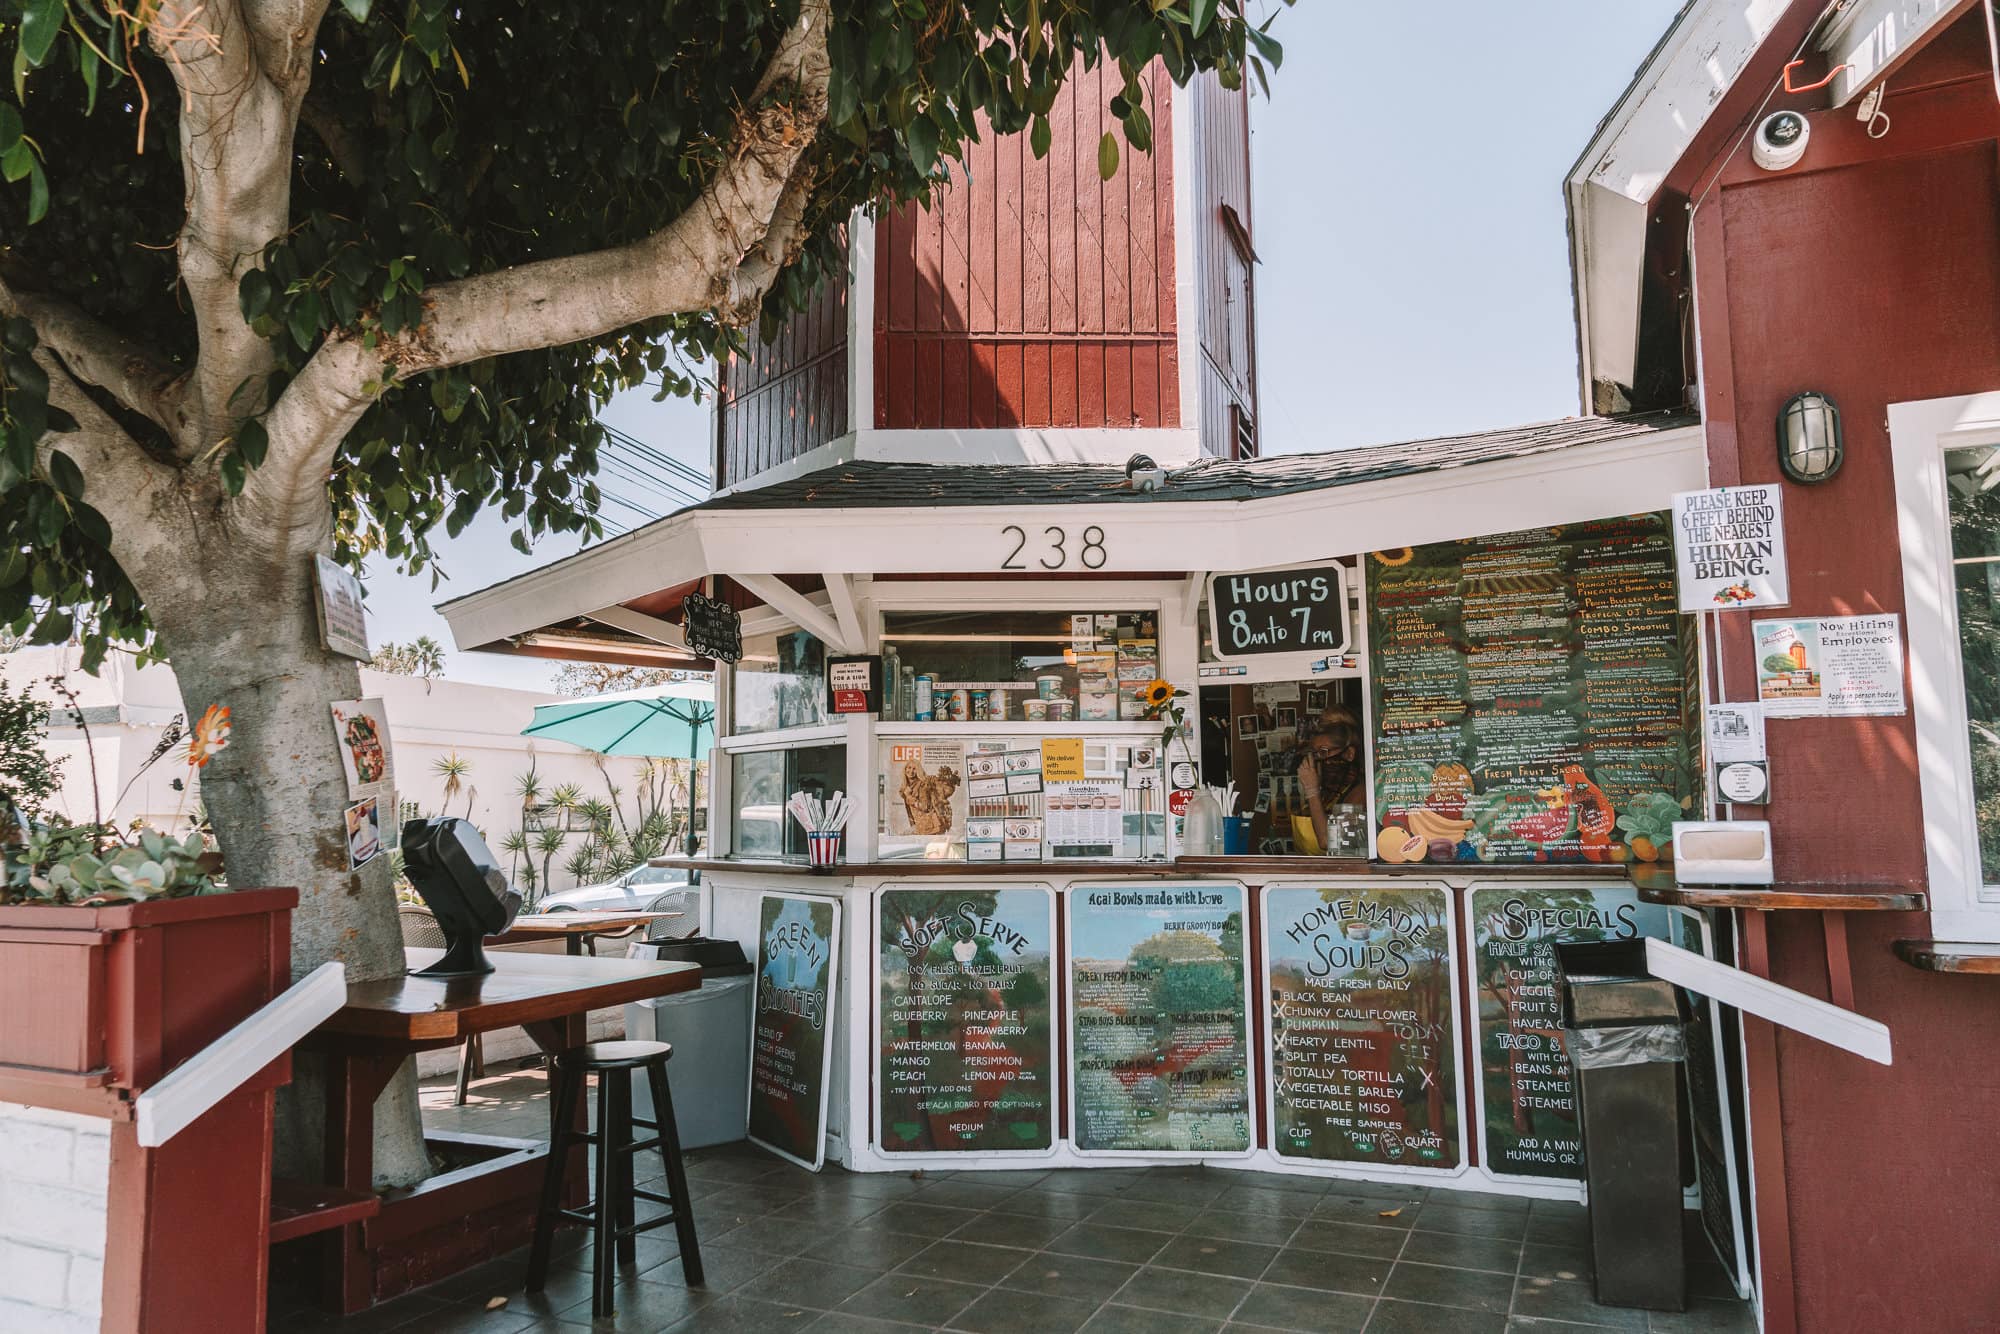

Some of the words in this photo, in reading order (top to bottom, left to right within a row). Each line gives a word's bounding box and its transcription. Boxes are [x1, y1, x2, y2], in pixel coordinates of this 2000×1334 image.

[1686, 492, 1732, 512] PLEASE
[1735, 489, 1767, 507] KEEP
[1682, 512, 1689, 529] 6
[1692, 510, 1723, 527] FEET
[1727, 505, 1775, 525] BEHIND
[1686, 527, 1712, 544] THE
[1714, 522, 1772, 541] NEAREST
[1001, 525, 1107, 569] 238
[1688, 540, 1773, 563] HUMAN
[1695, 559, 1770, 580] BEING.
[1230, 576, 1329, 605] Hours
[1577, 588, 1623, 597] PINEAPPLE
[1579, 610, 1621, 618] TROPICAL
[1647, 608, 1678, 616] BANANA
[1396, 624, 1436, 632] GRAPEFRUIT
[1580, 625, 1619, 634] COMBO
[1624, 623, 1670, 632] SMOOTHIE
[1820, 622, 1844, 631] Now
[1850, 620, 1894, 630] Hiring
[1396, 632, 1445, 640] WATERMELON
[1822, 636, 1894, 647] Employees
[1828, 692, 1845, 700] Apply
[1400, 720, 1429, 729] HERBAL
[1432, 718, 1446, 726] TEA
[1589, 726, 1632, 734] BLUEBERRY
[894, 746, 921, 761] LIFE
[1484, 768, 1513, 779] FRESH
[1518, 766, 1545, 776] FRUIT
[1552, 764, 1584, 776] SALAD
[1386, 776, 1425, 784] GRANOLA
[1387, 793, 1428, 802] OATMEAL
[1089, 892, 1112, 906] Acai
[1114, 892, 1143, 906] Bowls
[1146, 890, 1173, 905] made
[1175, 891, 1196, 904] with
[1164, 922, 1186, 931] BERRY
[1286, 900, 1430, 946] HOMEMADE
[1502, 899, 1638, 942] SPECIALS
[901, 916, 951, 957] SOFT
[955, 901, 1029, 955] SERVE
[768, 922, 820, 969] GREEN
[1488, 942, 1527, 956] HALF
[1307, 934, 1410, 980] SOUPS
[1518, 957, 1545, 967] WITH
[962, 964, 996, 975] FROZEN
[998, 964, 1024, 974] FRUIT
[1510, 970, 1534, 980] CUP
[1131, 972, 1154, 980] BOWL
[912, 980, 924, 990] NO
[931, 980, 961, 990] SUGAR
[969, 980, 983, 990] NO
[988, 980, 1016, 990] DAIRY
[1304, 978, 1334, 988] MADE
[1340, 978, 1371, 989] FRESH
[1378, 980, 1411, 990] DAILY
[760, 973, 824, 1030] SMOOTHIES
[894, 995, 952, 1006] CANTALOPE
[1283, 992, 1316, 1002] BLACK
[1322, 993, 1350, 1002] BEAN
[1512, 1001, 1544, 1013] FRUIT
[893, 1010, 947, 1021] BLUEBERRY
[964, 1010, 1017, 1021] PINEAPPLE
[1285, 1006, 1330, 1017] CHUNKY
[1336, 1008, 1418, 1022] CAULIFLOWER
[1116, 1016, 1138, 1026] BLUE
[1286, 1020, 1339, 1031] PUMPKIN
[1512, 1018, 1541, 1030] HAVE
[758, 1026, 775, 1040] BLEND
[776, 1031, 784, 1042] OF
[966, 1026, 1028, 1036] STRAWBERRY
[893, 1042, 956, 1050] WATERMELON
[965, 1042, 1006, 1050] BANANA
[1286, 1036, 1328, 1048] HEARTY
[1334, 1038, 1376, 1050] LENTIL
[1496, 1033, 1541, 1050] TACO
[1550, 1038, 1560, 1050] &
[775, 1046, 796, 1062] GREENS
[1286, 1052, 1317, 1062] SPLIT
[1324, 1054, 1348, 1064] PEA
[1528, 1052, 1550, 1062] WITH
[892, 1056, 930, 1066] MANGO
[965, 1056, 1022, 1066] PERSIMMON
[774, 1060, 793, 1076] FRUITS
[1516, 1063, 1552, 1074] BEANS
[892, 1071, 926, 1081] PEACH
[964, 1072, 996, 1081] LEMON
[1288, 1066, 1334, 1080] TOTALLY
[1342, 1069, 1404, 1084] TORTILLA
[792, 1081, 808, 1095] JUICE
[910, 1086, 937, 1094] NUTTY
[1287, 1082, 1351, 1095] VEGETABLE
[1358, 1087, 1404, 1099] BARLEY
[1517, 1080, 1570, 1092] STEAMED
[768, 1086, 788, 1100] BANANA
[955, 1101, 980, 1109] BOARD
[984, 1101, 1000, 1109] FOR
[1287, 1098, 1353, 1112] VEGETABLE
[1358, 1103, 1390, 1114] MISO
[950, 1124, 984, 1132] MEDIUM
[1326, 1117, 1352, 1128] FREE
[1357, 1119, 1402, 1130] SAMPLES
[1289, 1128, 1312, 1138] CUP
[1352, 1132, 1378, 1143] PINT
[1404, 1136, 1443, 1148] QUART
[1518, 1138, 1538, 1149] ADD
[1544, 1140, 1550, 1150] A
[1506, 1150, 1556, 1164] HUMMUS
[1560, 1153, 1576, 1164] OR
